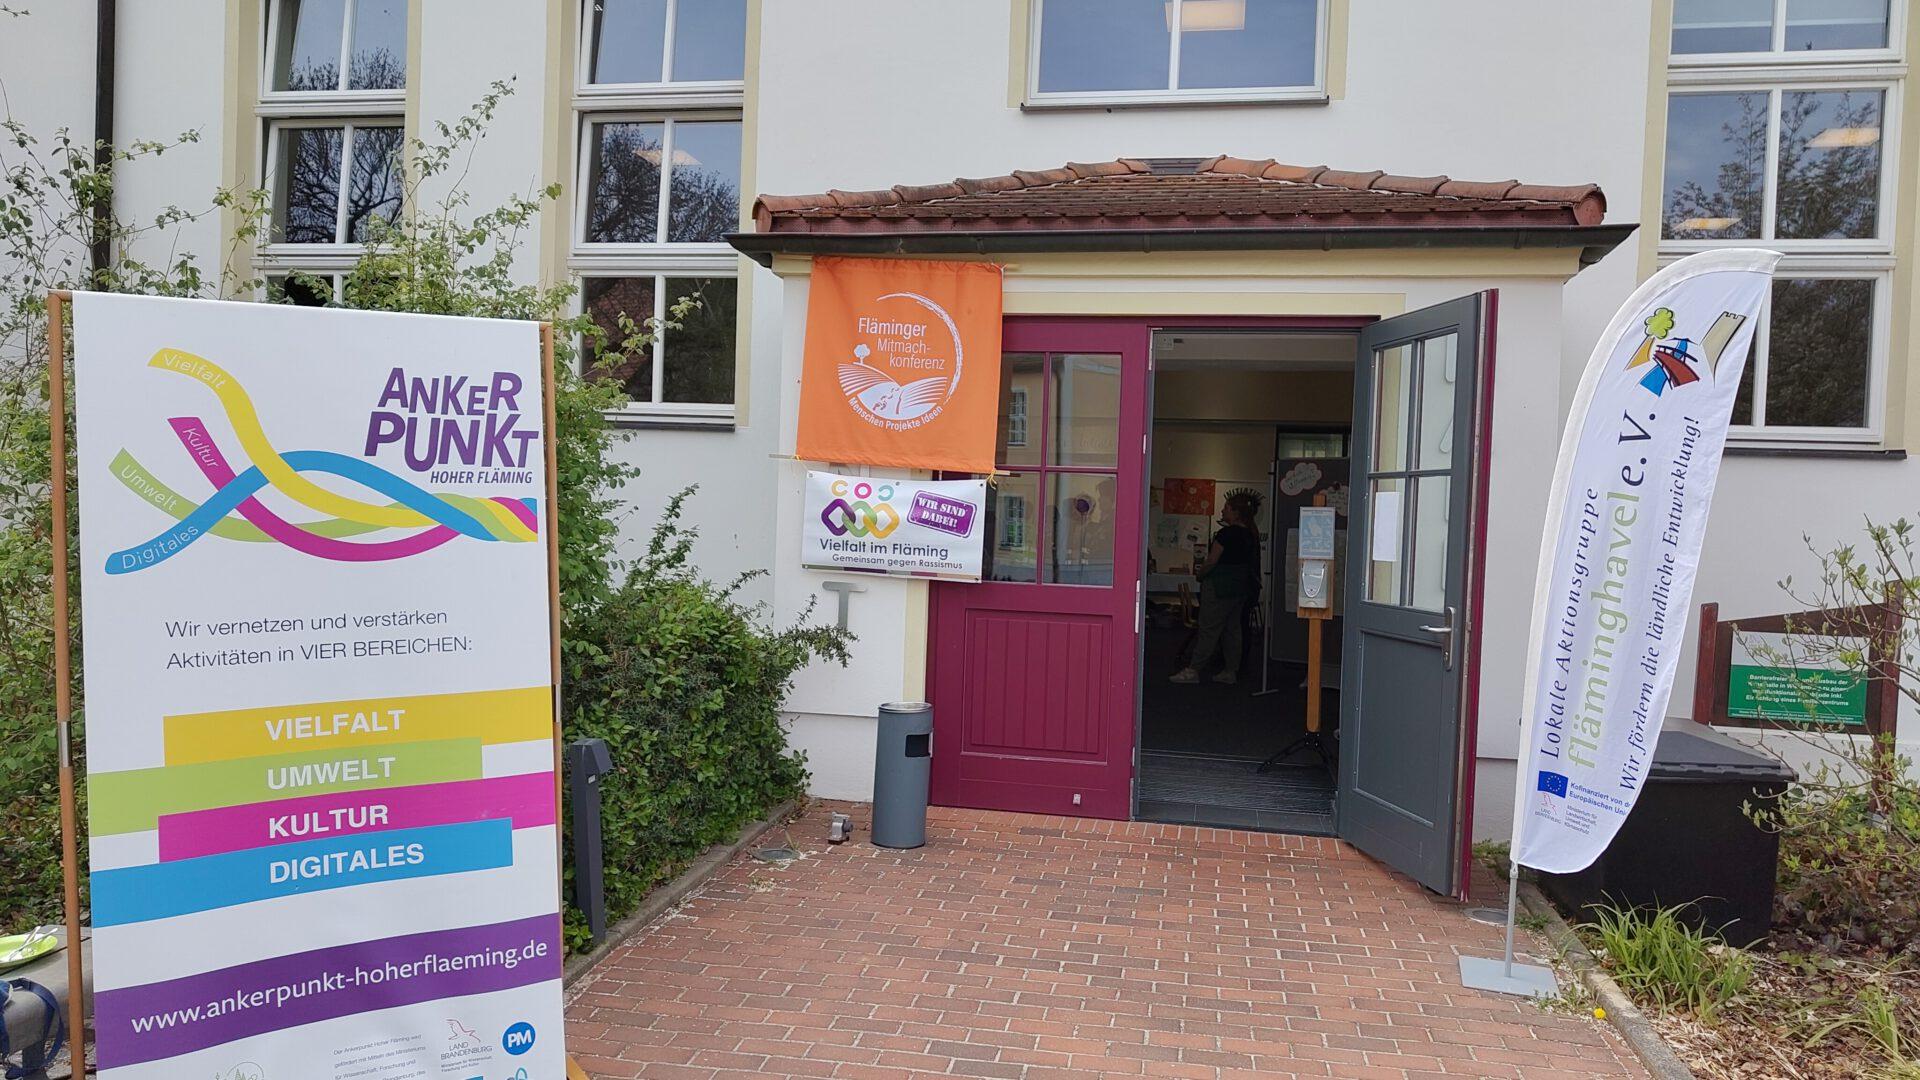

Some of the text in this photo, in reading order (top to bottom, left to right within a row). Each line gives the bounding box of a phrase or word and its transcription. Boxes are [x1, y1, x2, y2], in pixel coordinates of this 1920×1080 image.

[858, 317, 926, 339] Fläminger
[878, 338, 931, 354] Mitmach-
[889, 354, 945, 370] konferenz
[163, 353, 226, 389] Vielfalt
[377, 366, 523, 416] ANKER
[848, 397, 943, 432] Menschen Projekte Ideen
[182, 428, 220, 467] Kultur
[363, 411, 539, 473] PUNKT
[121, 465, 177, 511] Umwelt
[430, 466, 534, 485] HOHER FLÄMING
[918, 497, 966, 518] WIR SIND
[922, 510, 958, 528] DABEI!
[122, 526, 199, 569] Digitales
[820, 538, 948, 560] Vielfalt im Fläming
[832, 554, 962, 570] Gemeinsam gegen Rassismus
[1619, 416, 1701, 790] Wir fördern die ländliche Entwicklung!
[165, 608, 448, 639] Wir vernetzen und verstärken
[1540, 488, 1599, 760] Lokale Aktionsgruppe
[1568, 492, 1640, 769] fläminghavel
[166, 636, 472, 670] Aktivitäten in VIER BEREICHEN:
[265, 709, 406, 741] VIELFALT
[267, 756, 396, 790] UMWELT
[1569, 790, 1613, 811] Europäischen
[1570, 782, 1610, 800] Kofinanziert
[1610, 797, 1623, 805] von
[269, 804, 389, 839] KULTUR
[269, 843, 424, 886] DIGITALES
[131, 940, 548, 1034] www.ankerpunkt-hoherflaeming.de
[440, 1046, 492, 1060] BRANDENBURG
[449, 1041, 468, 1051] LAND
[507, 1029, 532, 1048] PM
